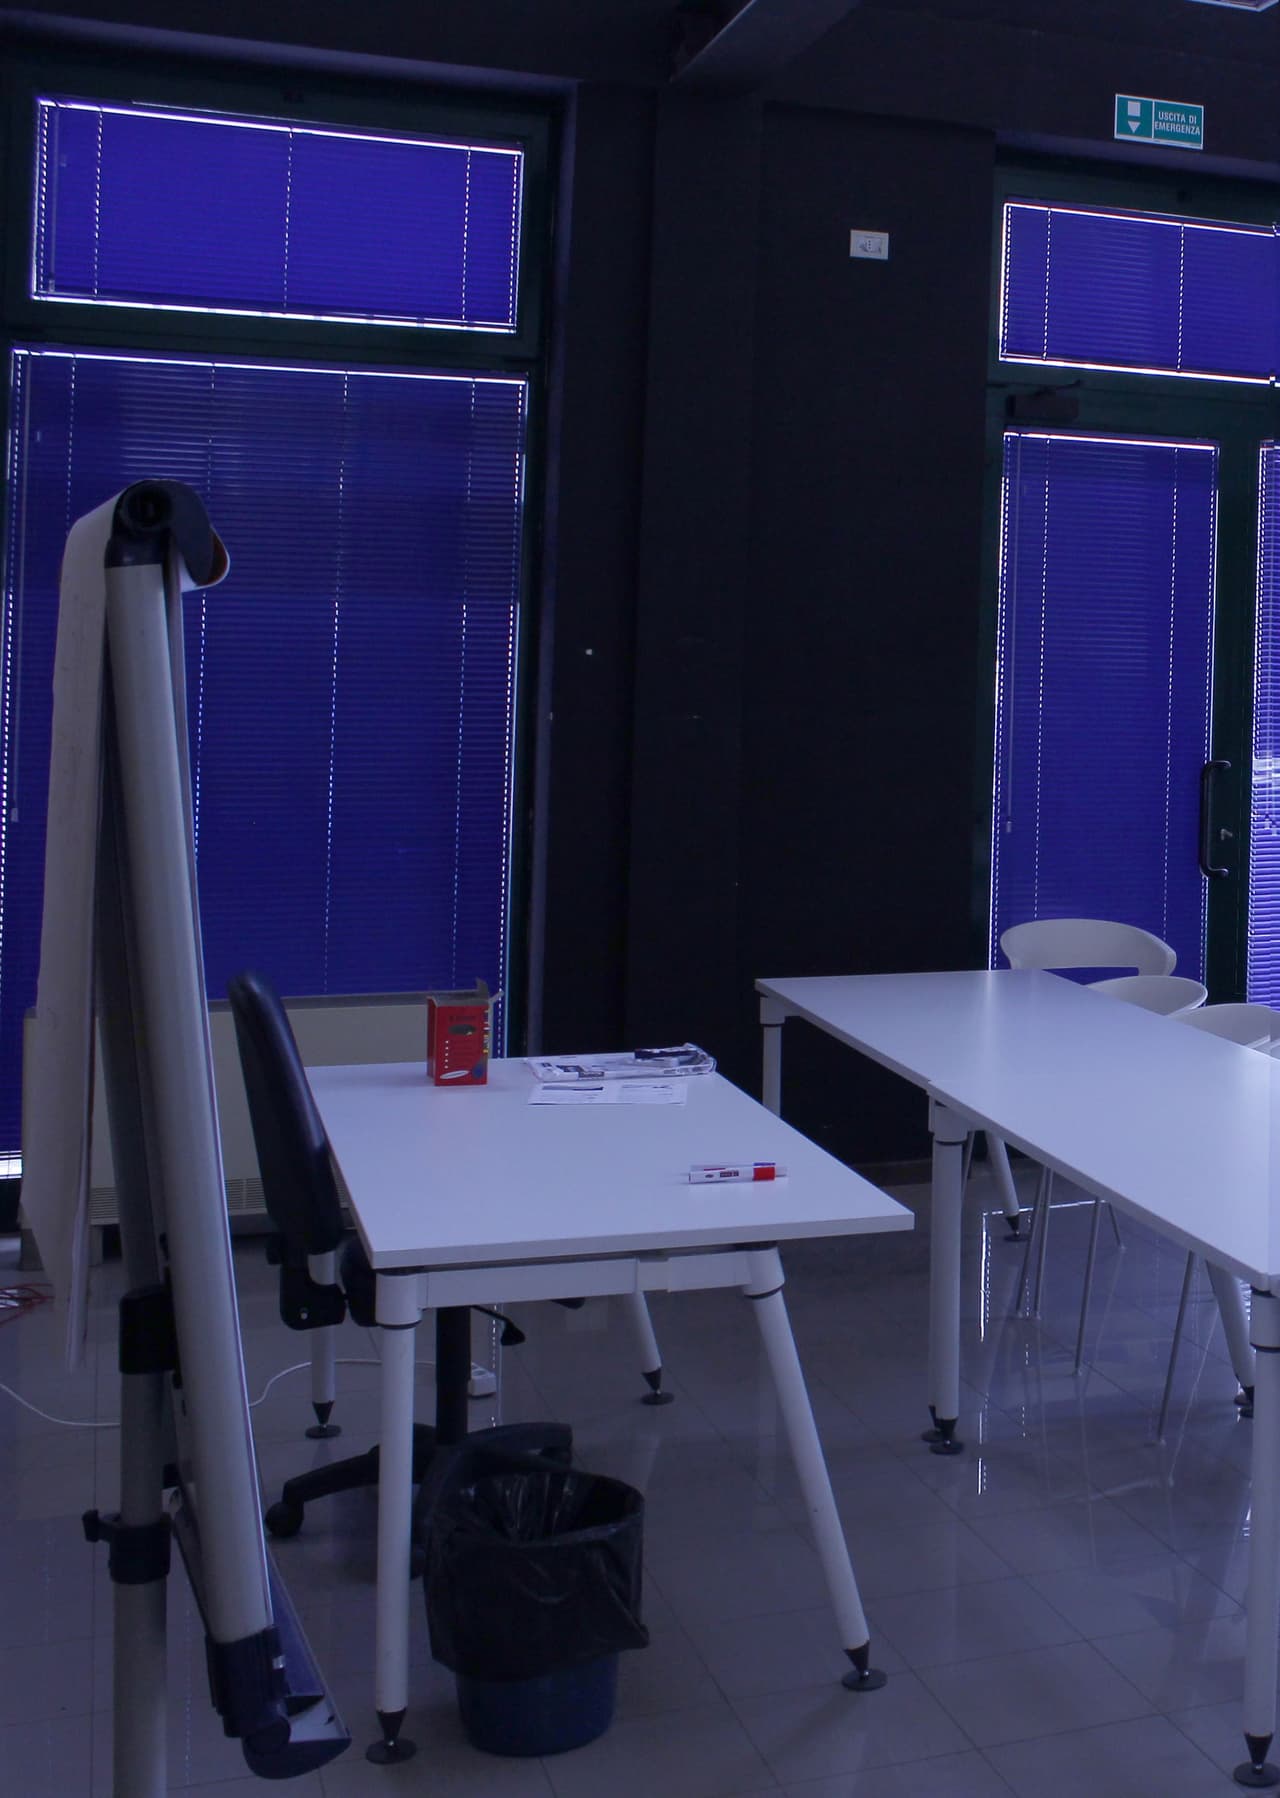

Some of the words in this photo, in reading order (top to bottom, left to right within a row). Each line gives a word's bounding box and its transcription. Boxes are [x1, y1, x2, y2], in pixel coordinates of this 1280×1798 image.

[1158, 111, 1186, 123] USCITA
[1189, 115, 1197, 124] DI
[1154, 121, 1200, 135] EMERGENZA
